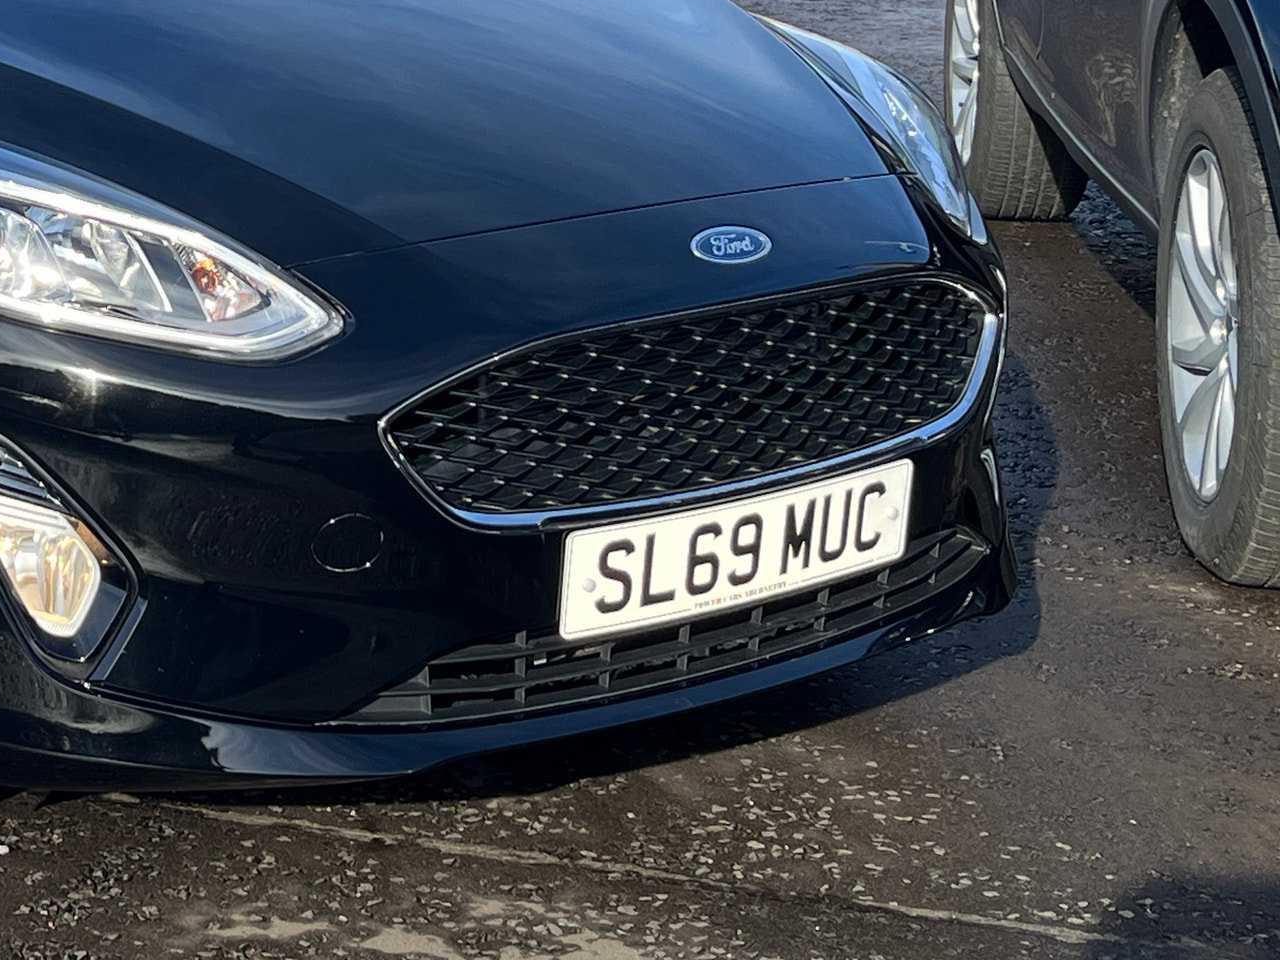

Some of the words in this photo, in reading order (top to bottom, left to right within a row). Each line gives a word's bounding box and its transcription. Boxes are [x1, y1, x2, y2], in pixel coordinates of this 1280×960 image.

[710, 233, 755, 256] Ford
[594, 512, 764, 614] SL69
[778, 480, 887, 576] MUC
